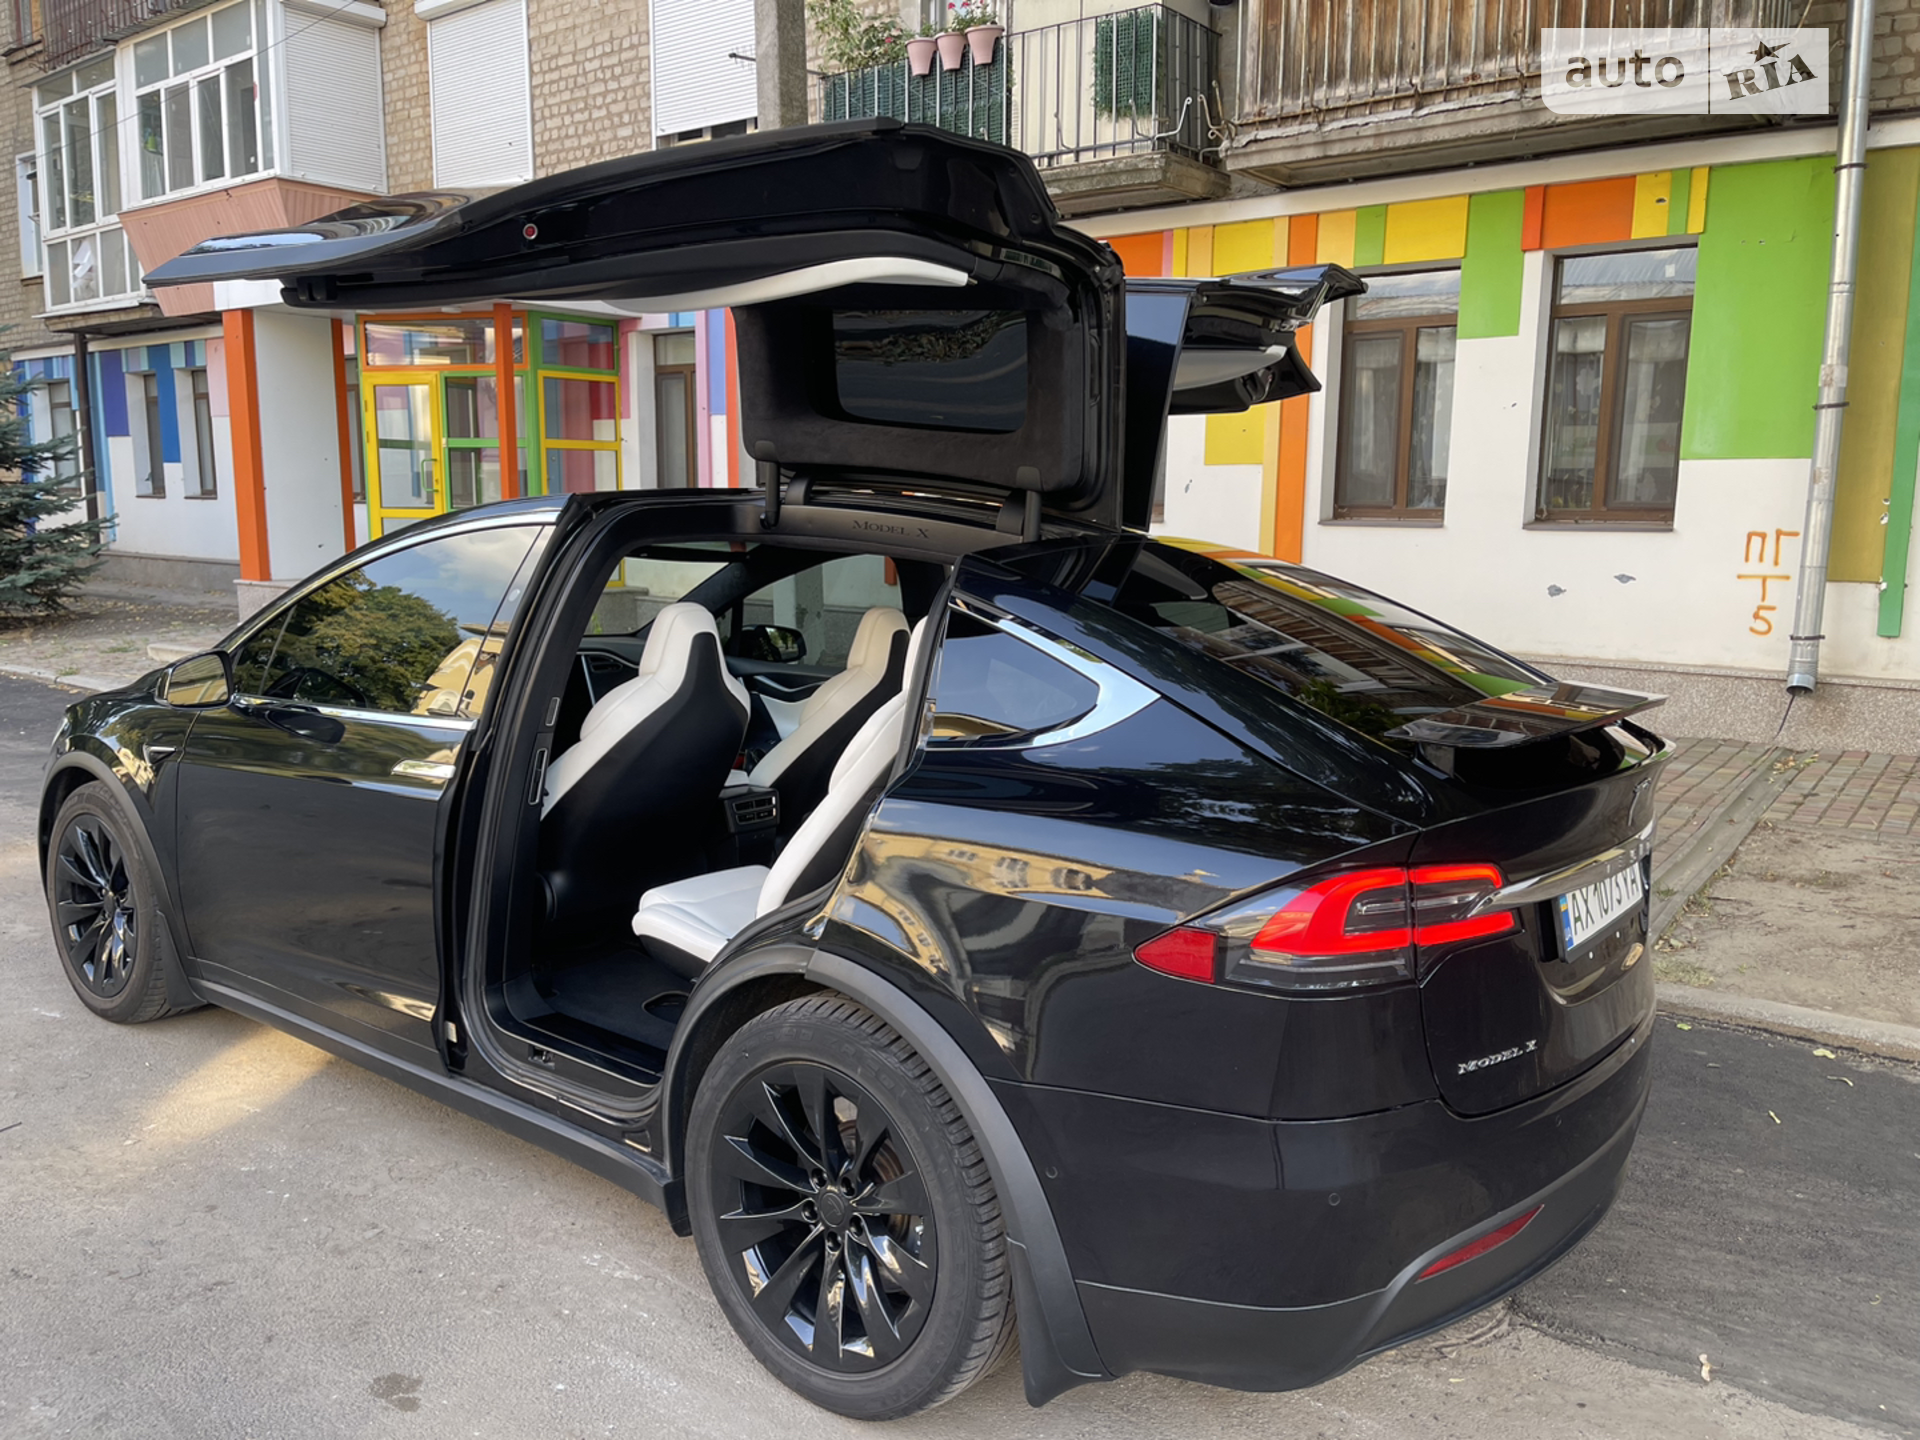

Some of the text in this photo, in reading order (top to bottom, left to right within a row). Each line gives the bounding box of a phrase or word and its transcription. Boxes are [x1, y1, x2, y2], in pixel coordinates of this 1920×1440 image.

[852, 520, 929, 539] MODEL X
[1571, 885, 1595, 936] AX
[1458, 1039, 1538, 1075] MODEL X
